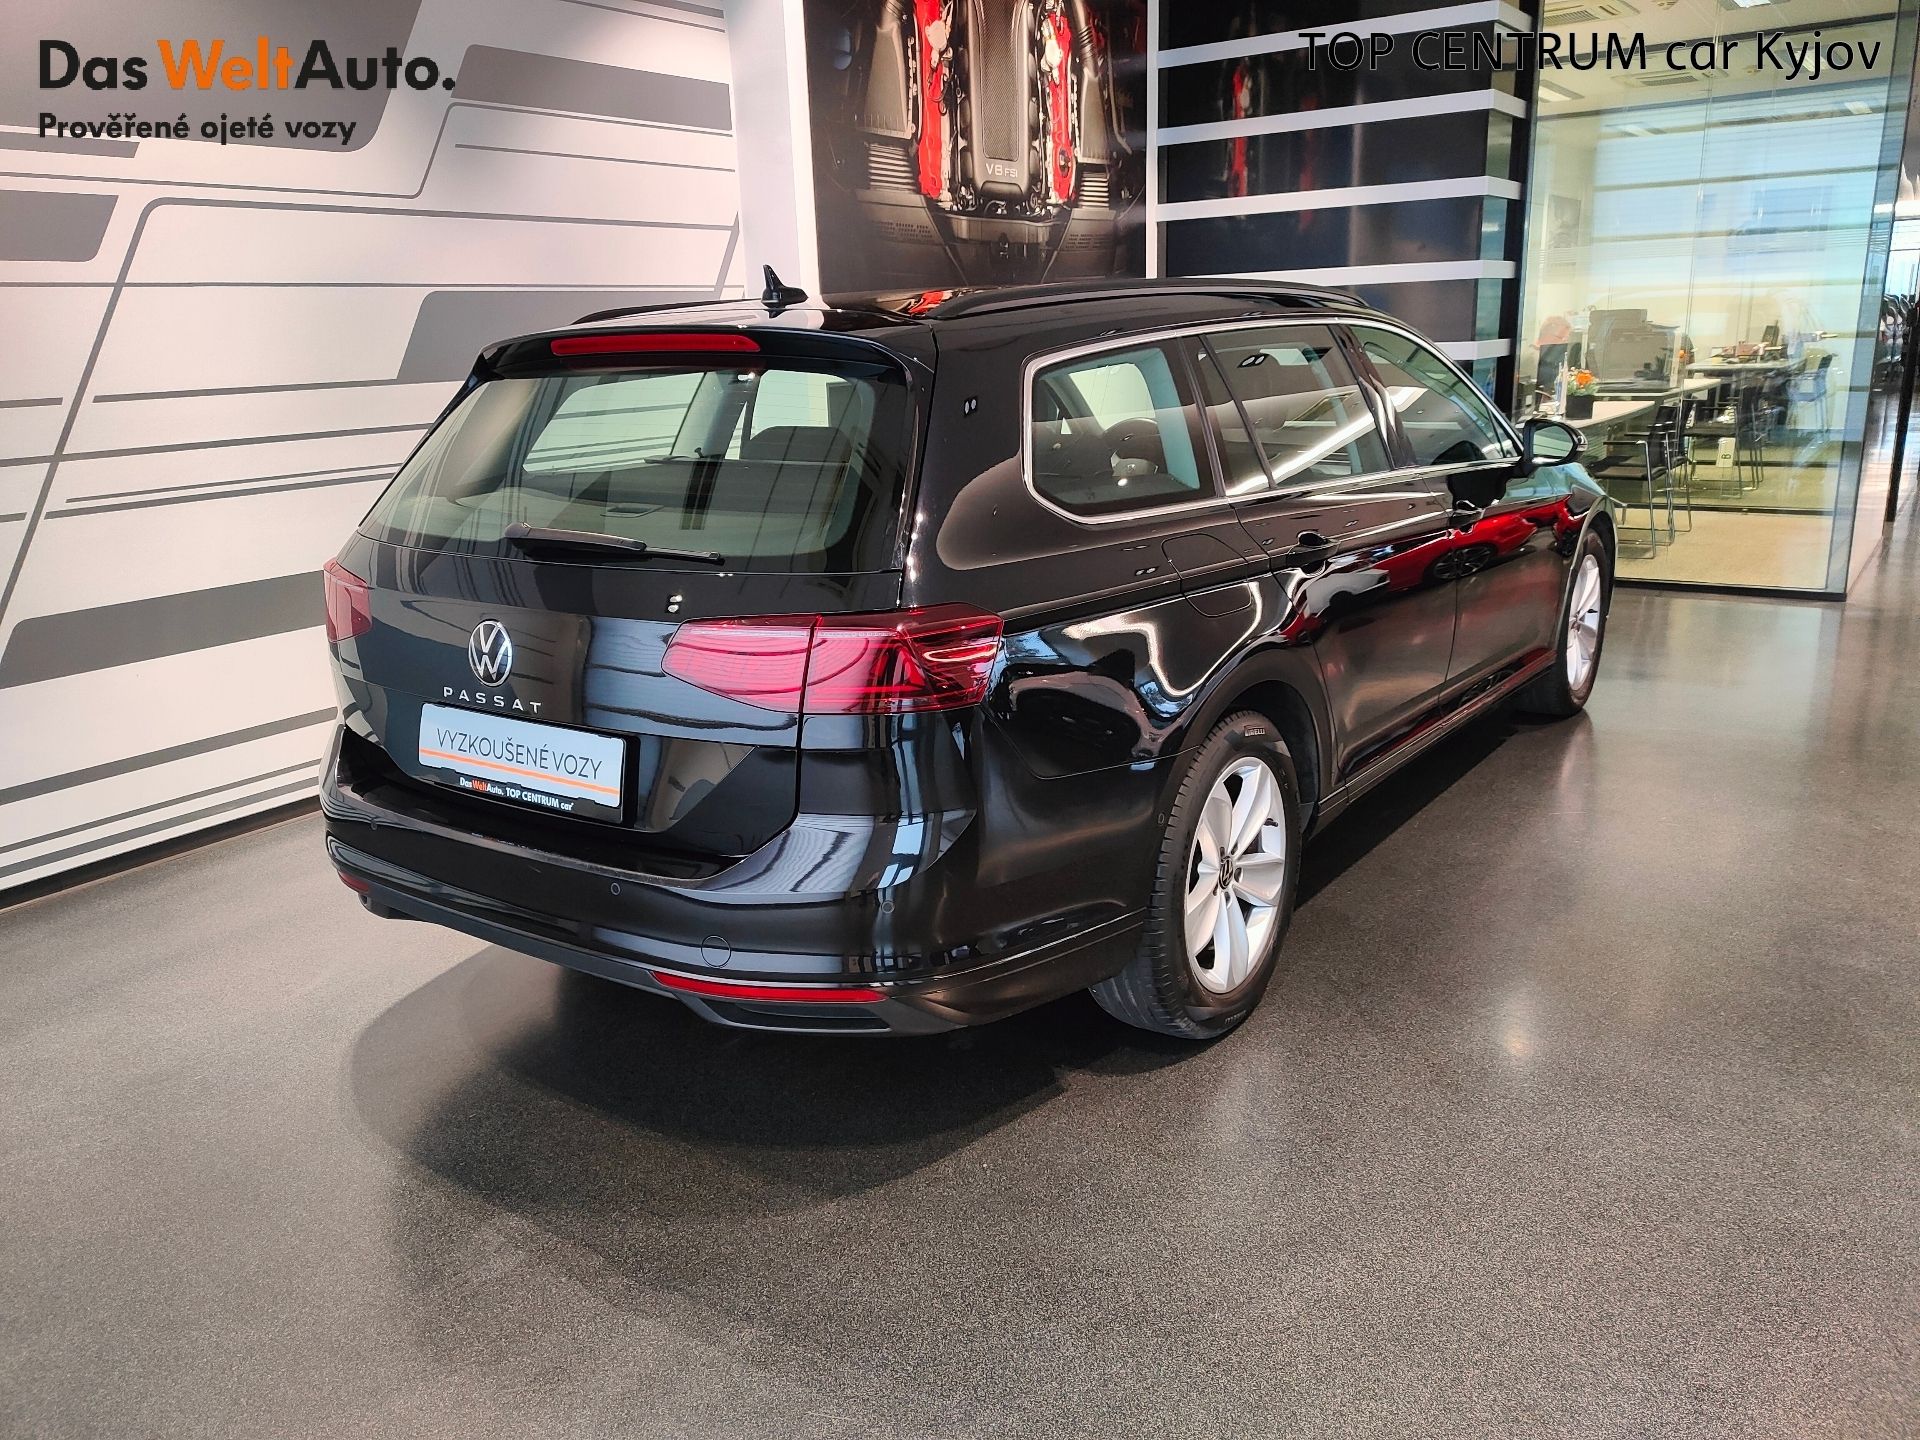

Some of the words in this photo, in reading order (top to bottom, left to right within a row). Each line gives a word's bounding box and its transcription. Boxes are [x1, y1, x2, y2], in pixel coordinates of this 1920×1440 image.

[443, 686, 542, 714] PASSAT
[436, 727, 550, 770] VYZKOUŠENÉ
[551, 750, 603, 780] VOZY
[506, 787, 521, 799] TOP
[522, 791, 560, 808] CENTRUM
